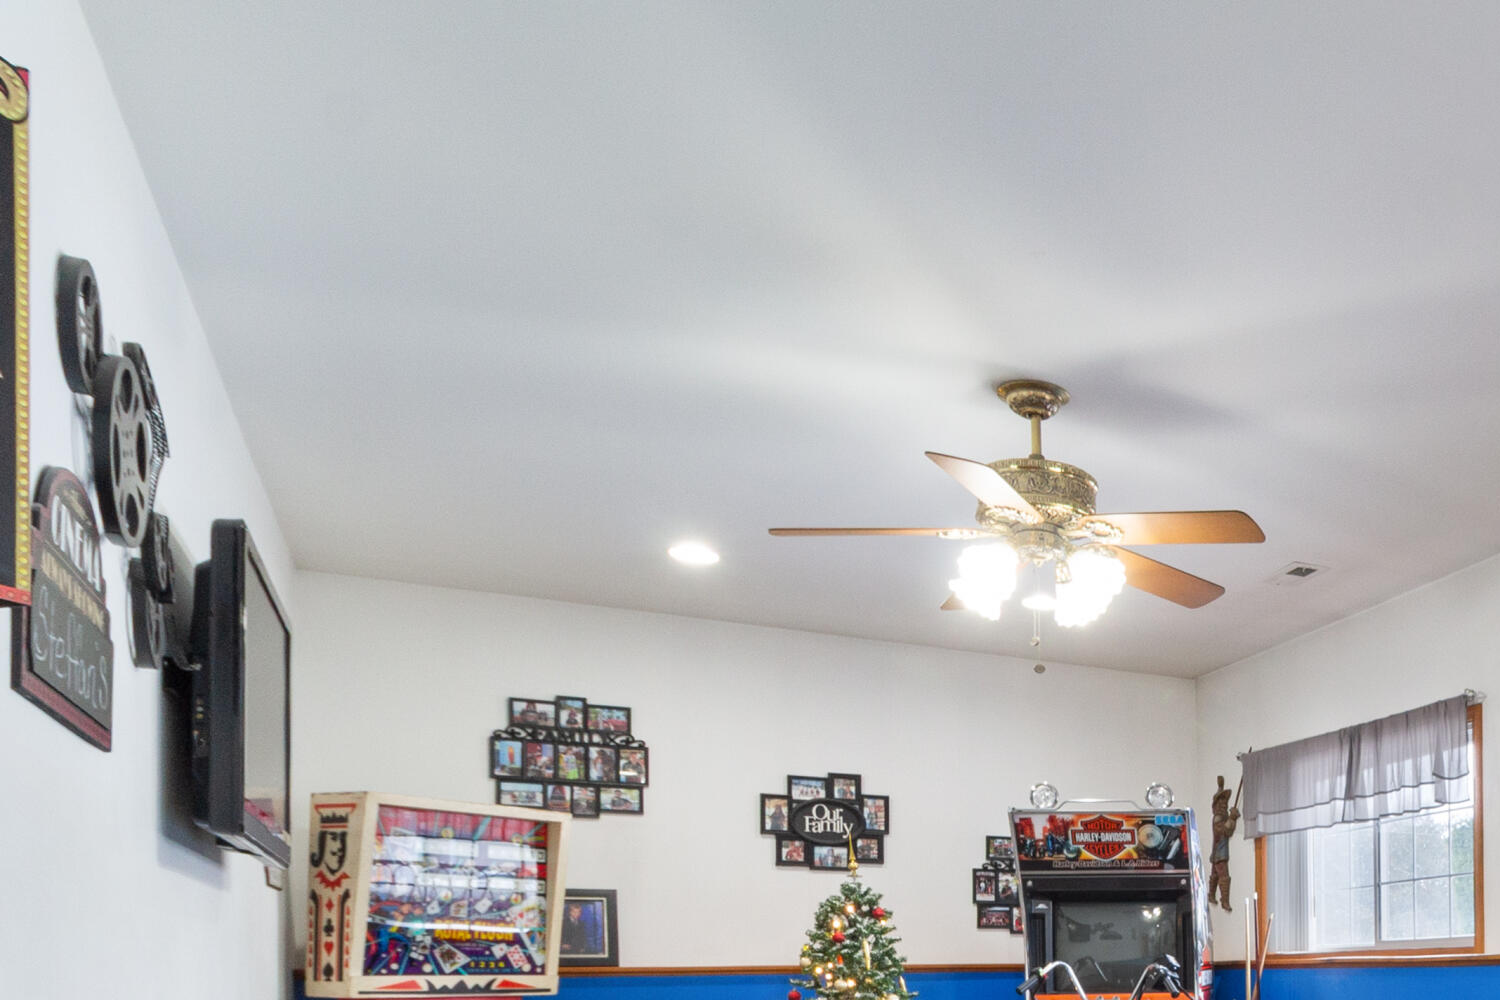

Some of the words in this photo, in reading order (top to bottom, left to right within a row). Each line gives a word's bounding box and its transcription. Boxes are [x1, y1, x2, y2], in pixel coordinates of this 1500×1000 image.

[49, 494, 102, 593] CINEMA
[812, 803, 843, 821] Our
[803, 815, 854, 839] Family
[1087, 821, 1117, 830] MOTOR
[1155, 815, 1184, 825] SEGA
[1075, 832, 1132, 843] HARLEY-DAVIDSON
